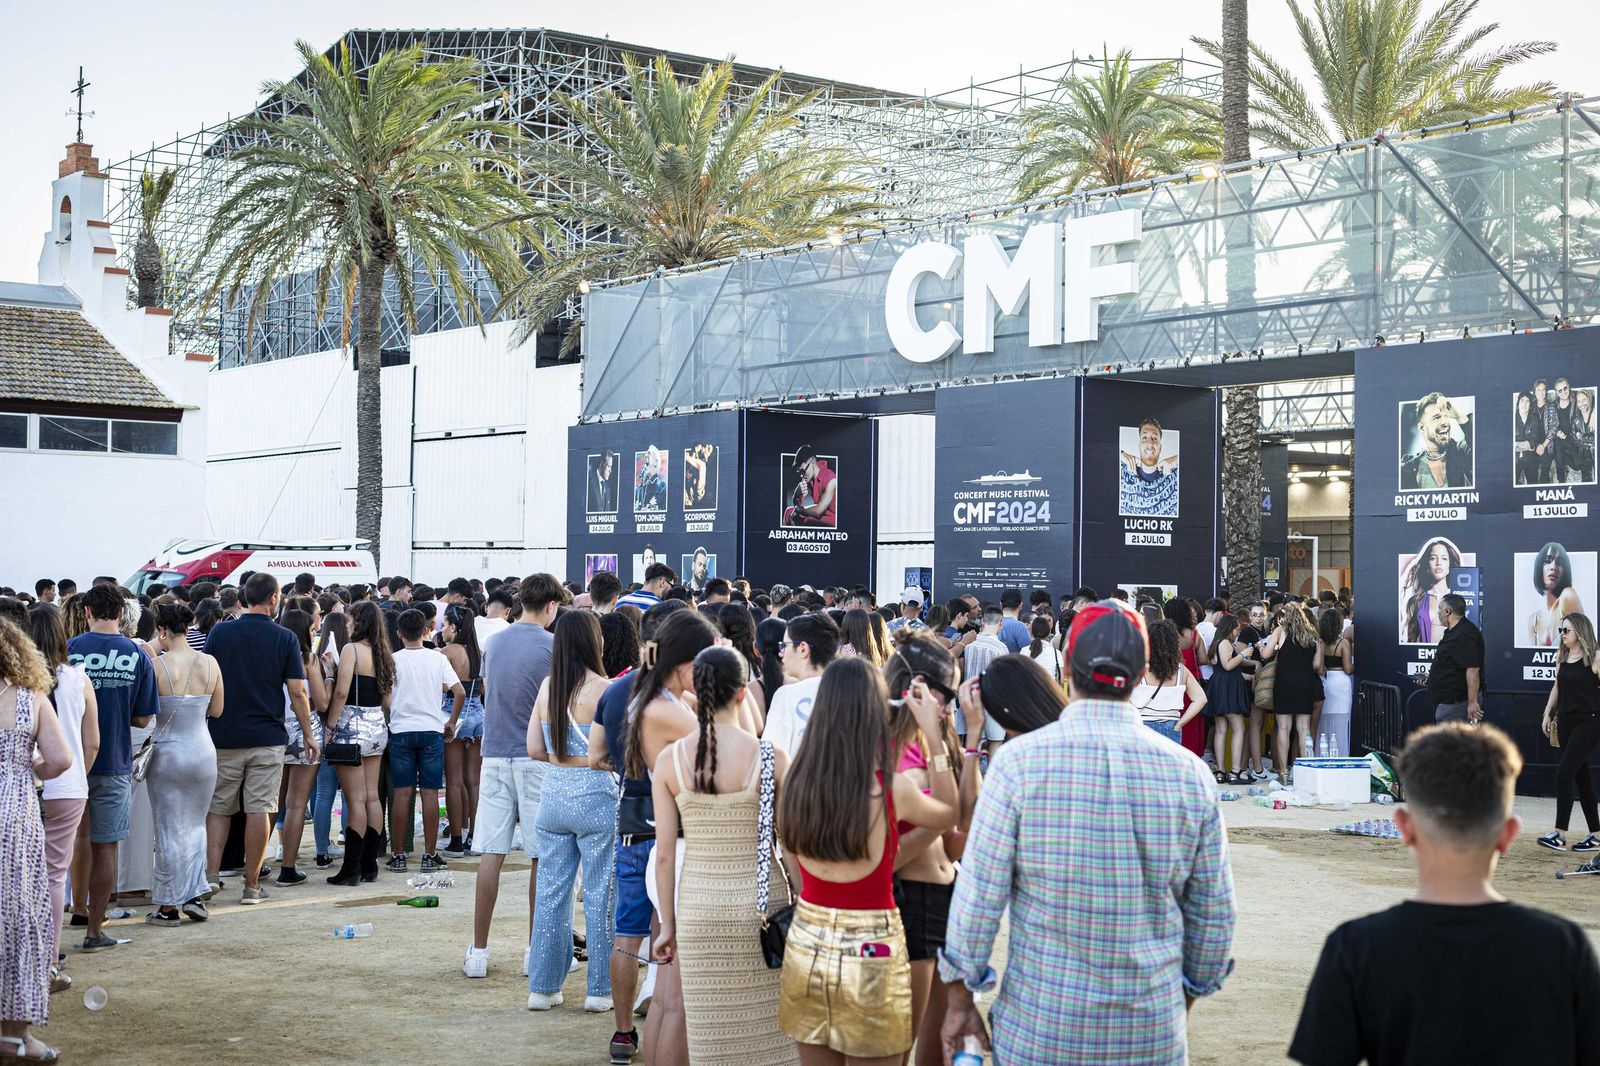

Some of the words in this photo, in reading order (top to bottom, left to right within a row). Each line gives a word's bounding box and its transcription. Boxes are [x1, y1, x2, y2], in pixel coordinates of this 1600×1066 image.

[885, 208, 1142, 363] CMF
[954, 491, 987, 499] CONCERT
[989, 490, 1012, 498] MUSIC
[1014, 490, 1050, 498] FESTIVAL
[1536, 486, 1575, 501] MANÁ
[1394, 494, 1430, 506] RICKY
[1432, 492, 1480, 505] MARTIN
[953, 500, 1051, 525] CMF2024
[1415, 510, 1425, 519] 14
[1427, 510, 1458, 519] JULIO
[1533, 508, 1543, 516] 11
[1544, 506, 1577, 516] JULIO
[585, 515, 598, 523] LUIS
[598, 515, 619, 523] MIGUEL
[634, 514, 647, 522] TOM
[647, 513, 666, 522] JONES
[684, 512, 716, 521] SCORPIONS
[647, 524, 660, 532] JULIO
[696, 523, 710, 531] JULIO
[1124, 519, 1158, 530] LUCHO
[1160, 520, 1173, 531] RK
[768, 530, 815, 540] ABRAHAM
[817, 531, 848, 541] MATEO
[1131, 535, 1140, 543] 21
[1141, 535, 1165, 544] JULIO
[787, 543, 797, 551] 03
[799, 544, 829, 552] AGOSTO
[267, 560, 324, 568] AMBULANCIA
[67, 649, 139, 672] cold
[1415, 665, 1426, 673] 10
[1532, 669, 1543, 678] 12
[85, 670, 136, 680] dwidetribe
